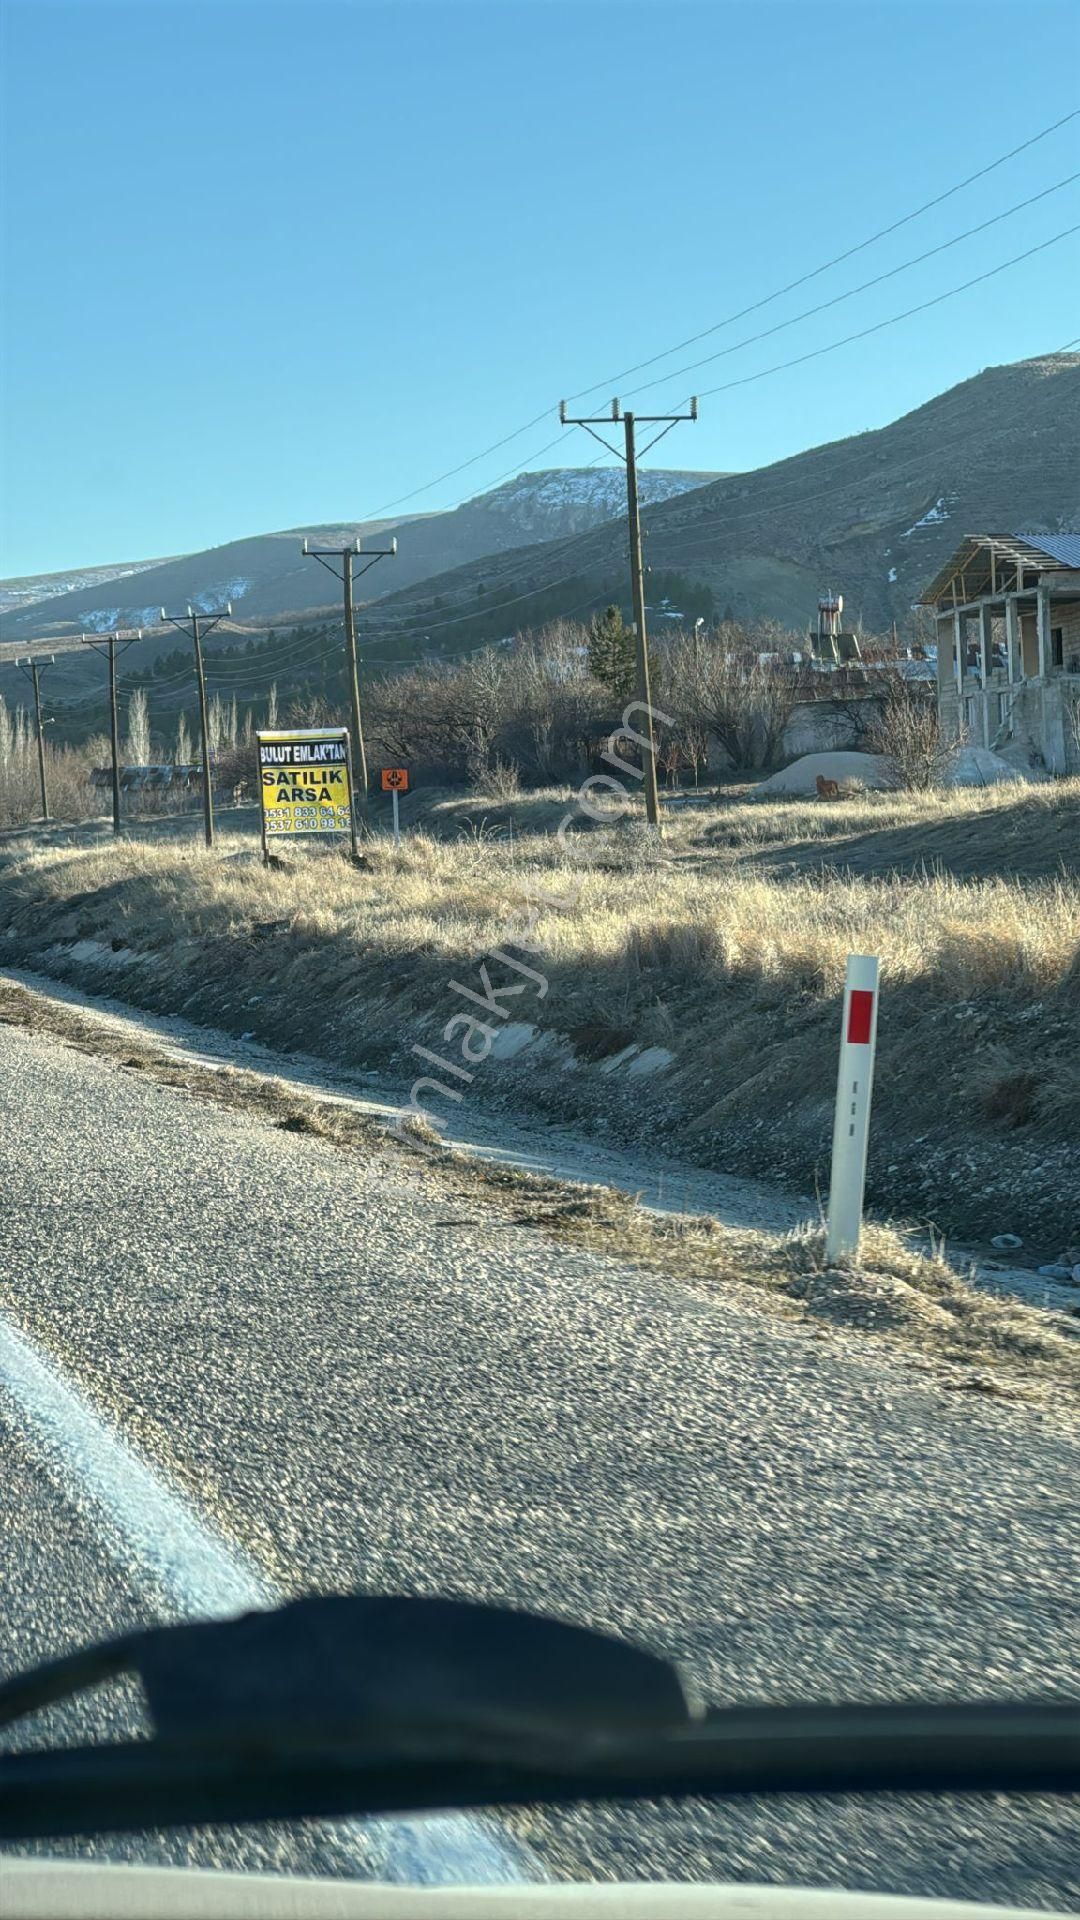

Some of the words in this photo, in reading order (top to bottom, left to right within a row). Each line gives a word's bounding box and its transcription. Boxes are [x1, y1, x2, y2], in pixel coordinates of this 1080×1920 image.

[261, 746, 291, 762] BULUT
[293, 743, 346, 762] EMLAK'TAN
[263, 770, 342, 786] SATILIK
[276, 788, 332, 802] ARSA
[294, 807, 317, 817] 833
[295, 819, 317, 830] 610
[320, 818, 336, 828] 98
